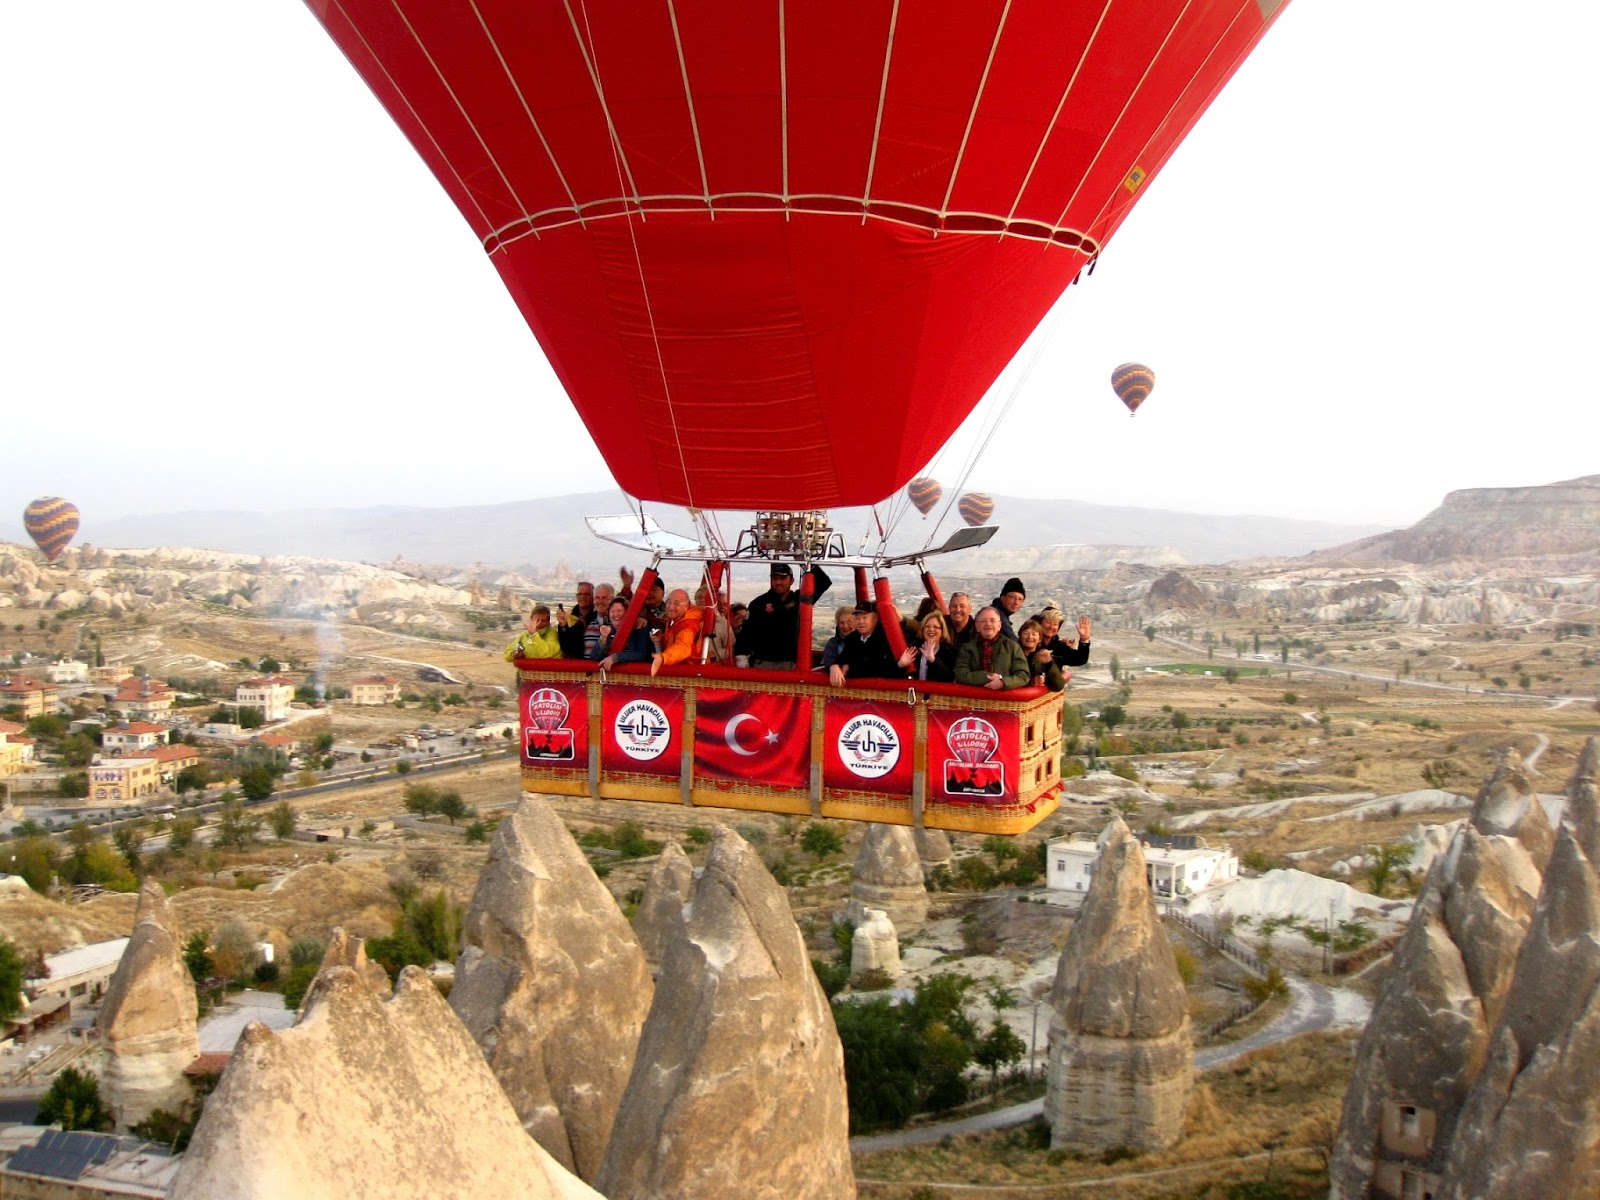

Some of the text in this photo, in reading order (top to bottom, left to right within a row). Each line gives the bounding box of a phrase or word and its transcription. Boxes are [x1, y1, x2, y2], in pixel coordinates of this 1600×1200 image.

[620, 704, 665, 726] ULUER HAVACILIK
[843, 719, 895, 742] ULUER HAVACILIK
[625, 745, 660, 753] TÜRKİYE
[957, 740, 988, 749] LLOONS
